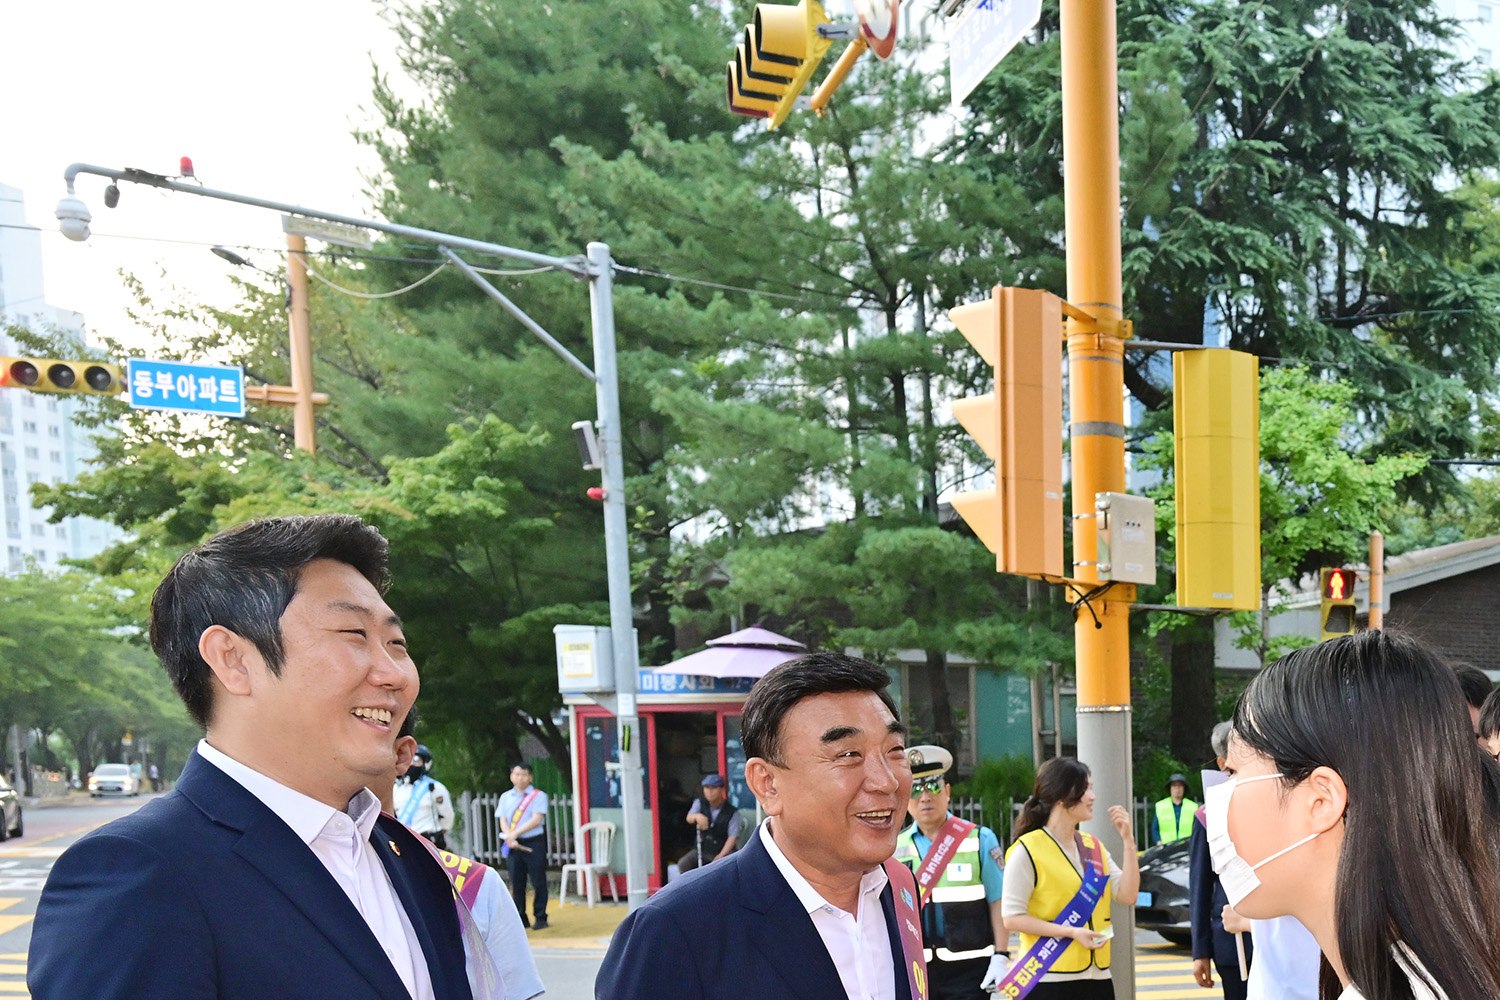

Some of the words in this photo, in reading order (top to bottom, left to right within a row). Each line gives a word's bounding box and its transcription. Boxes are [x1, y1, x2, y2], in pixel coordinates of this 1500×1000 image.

[133, 370, 239, 403] 동부아파트
[636, 674, 715, 692] 미봉사회
[1013, 956, 1044, 988] 먼저
[1038, 910, 1082, 961] 보내세요
